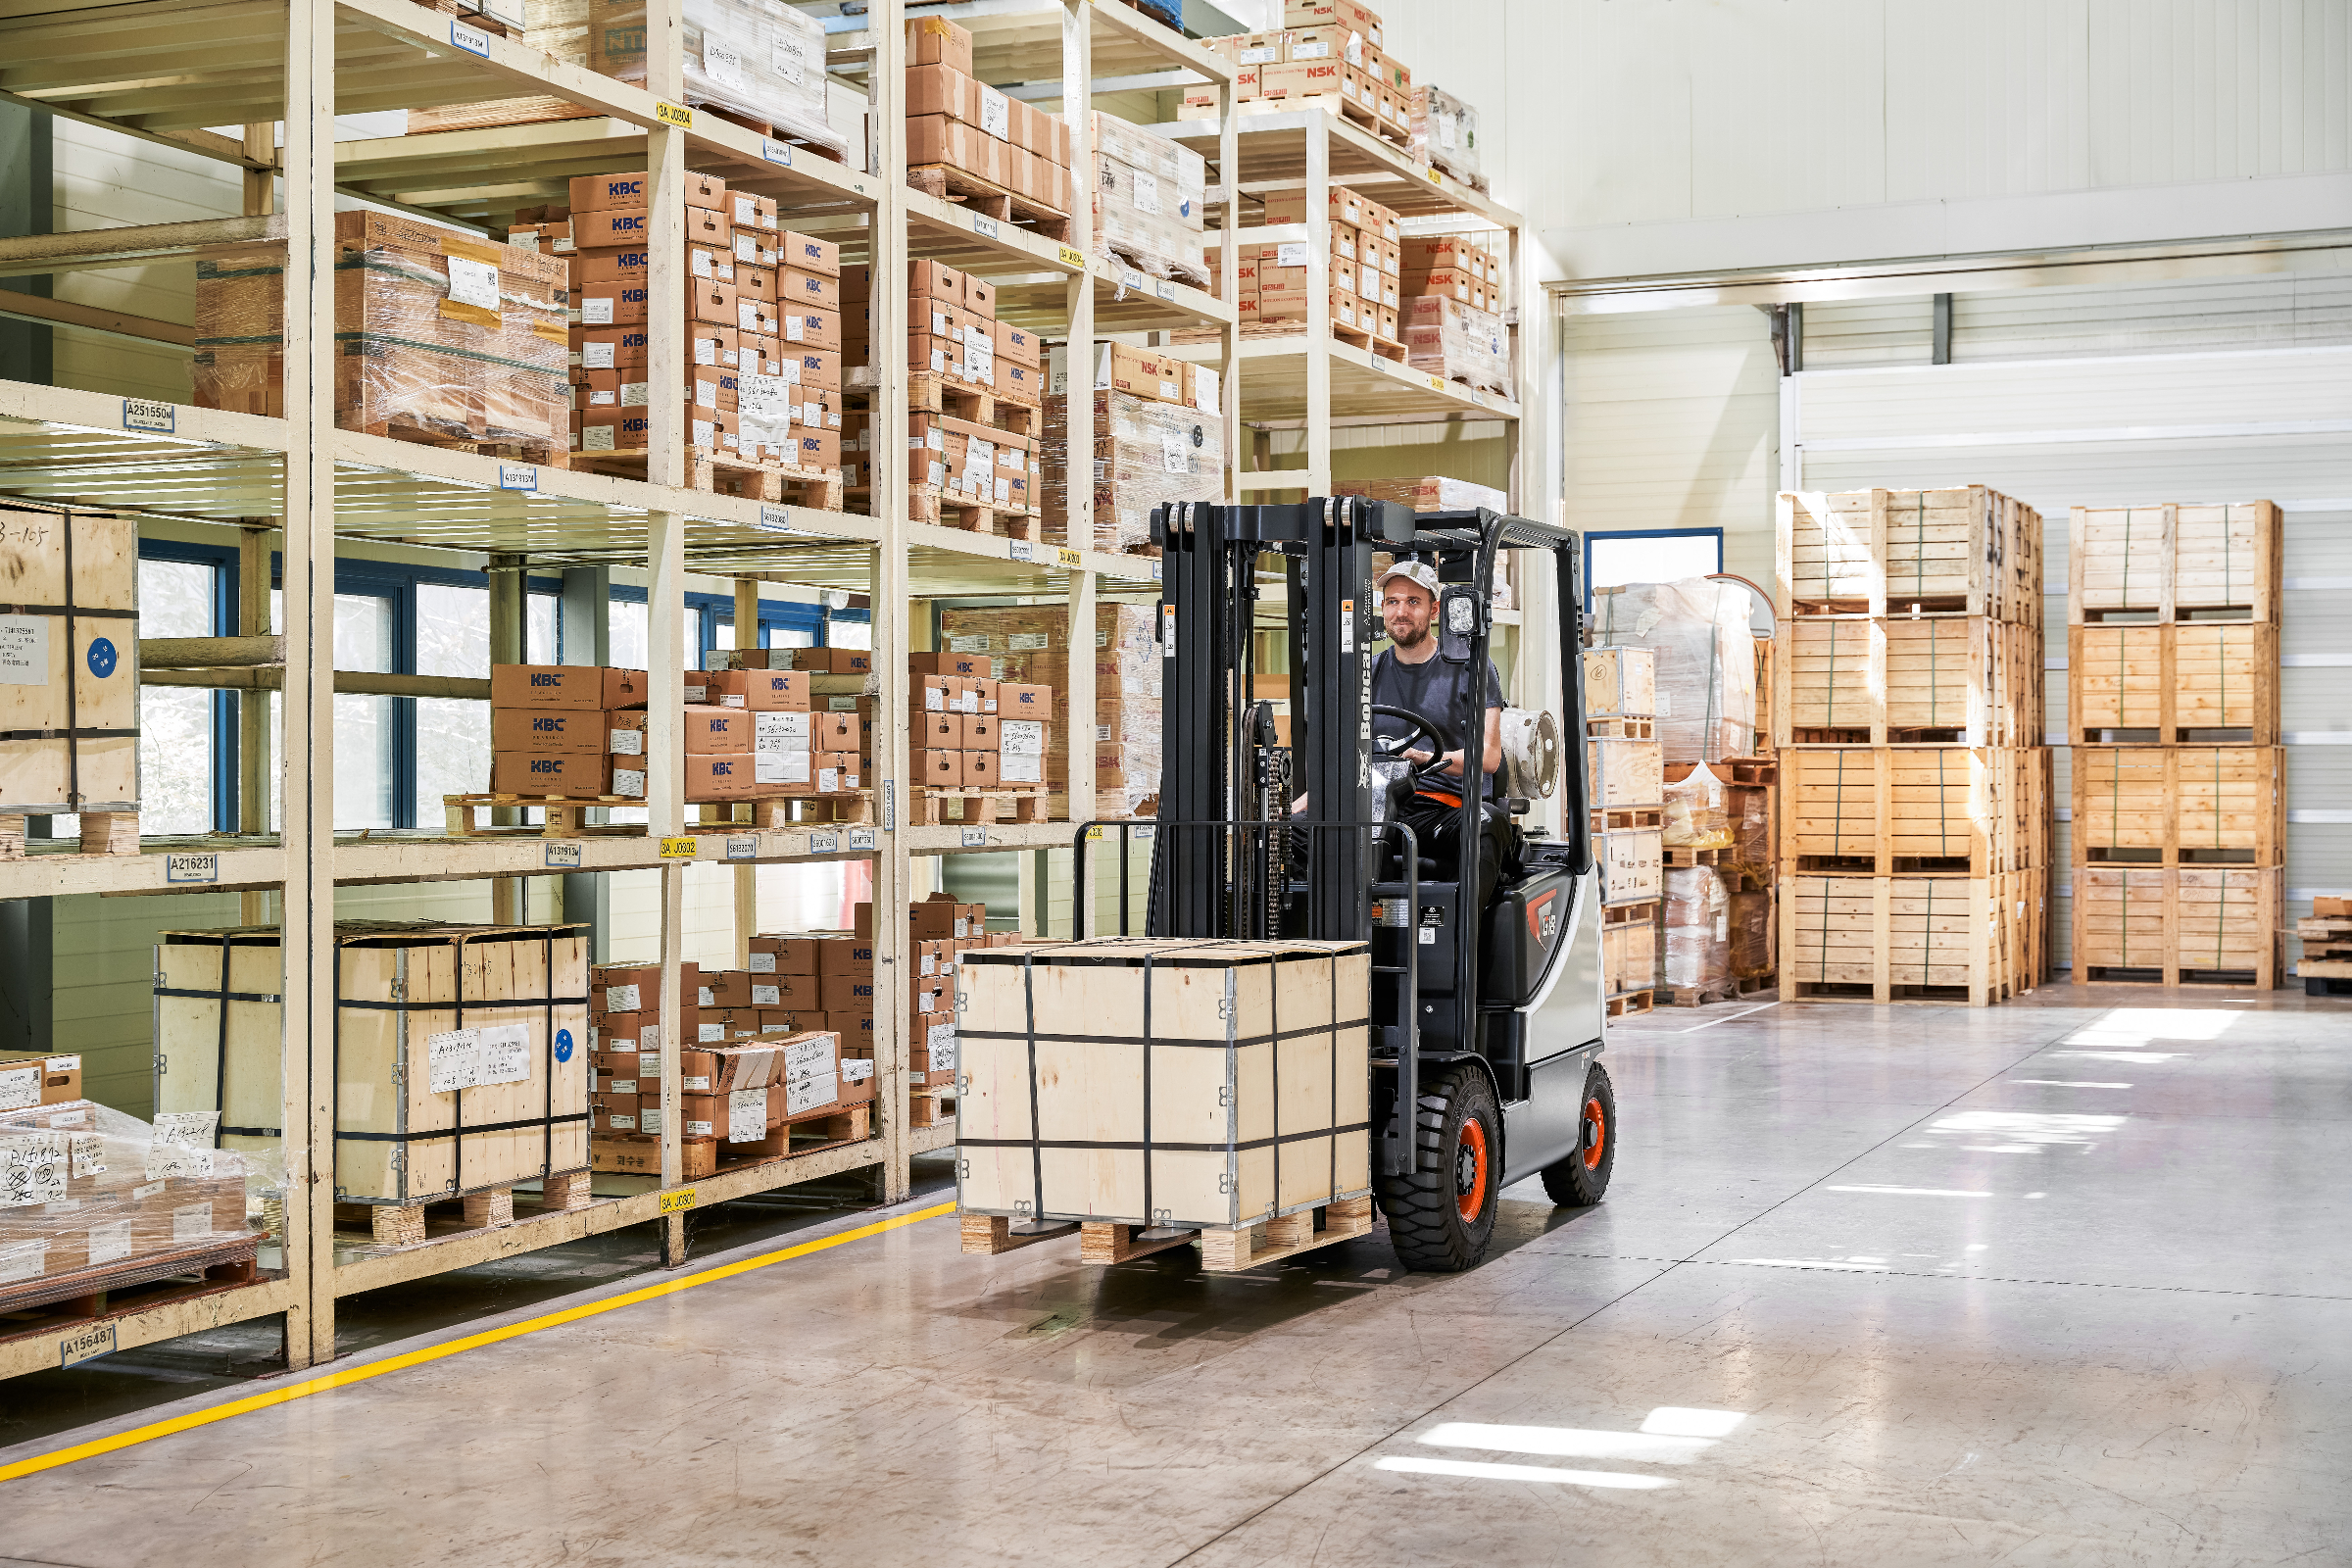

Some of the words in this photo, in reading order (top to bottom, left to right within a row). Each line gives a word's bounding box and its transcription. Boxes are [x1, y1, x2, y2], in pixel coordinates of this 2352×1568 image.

[1313, 6, 1333, 16] NSK
[1353, 7, 1367, 24] NSK
[607, 27, 647, 54] NT
[1306, 66, 1337, 78] NSK
[1238, 74, 1257, 85] SK
[609, 181, 642, 196] KBC
[612, 217, 646, 230] KBC
[806, 243, 821, 259] KBC
[1425, 243, 1453, 255] NSK
[1239, 267, 1256, 278] SK
[806, 277, 821, 293] KBC
[1425, 274, 1453, 285] NSK
[1239, 300, 1258, 312] SK
[1413, 303, 1442, 315] NSK
[806, 315, 822, 329] KBC
[1011, 331, 1025, 347] KBC
[1413, 332, 1442, 344] NSK
[804, 356, 822, 370] KBC
[1141, 361, 1158, 377] NSK
[1010, 367, 1024, 381] KBC
[803, 436, 822, 452] KBC
[1011, 477, 1026, 490] KBC
[1411, 485, 1439, 497] NSK
[851, 657, 868, 668] KBC
[956, 662, 973, 673] KBC
[1096, 662, 1119, 675] SK
[530, 673, 564, 687] KBC
[771, 677, 790, 690] KBC
[1360, 641, 1371, 740] Bobcat
[1019, 692, 1035, 704] KBC
[533, 717, 566, 732] KBC
[710, 718, 729, 732] KBC
[530, 760, 564, 773] KBC
[712, 762, 733, 776] KBC
[1096, 756, 1121, 769] SK
[661, 843, 671, 855] 3A
[171, 857, 215, 870] A216231
[853, 948, 873, 960] KB
[853, 984, 873, 997] KB
[662, 1198, 672, 1210] 3A
[65, 1327, 113, 1356] A156487
